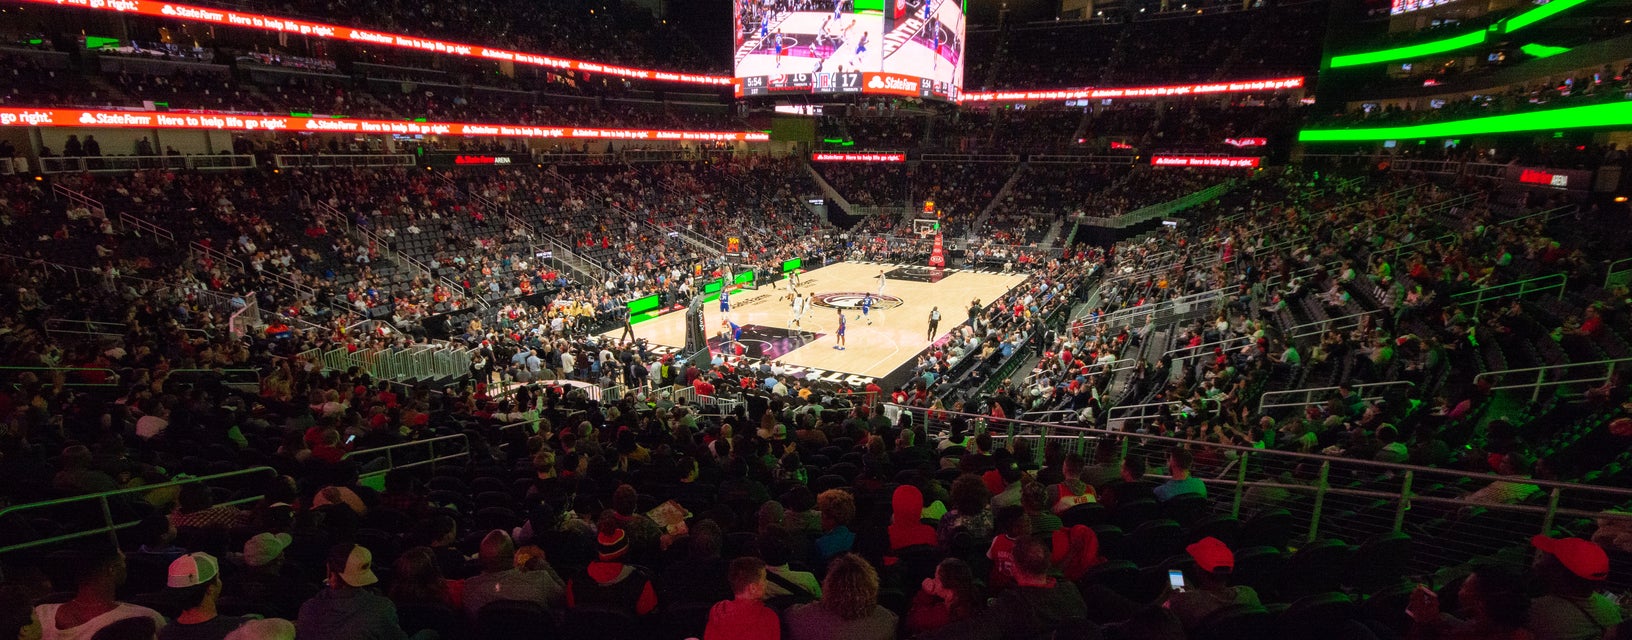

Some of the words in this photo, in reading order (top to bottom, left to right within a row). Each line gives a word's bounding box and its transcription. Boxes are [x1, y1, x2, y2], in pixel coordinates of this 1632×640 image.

[228, 14, 251, 24] Here
[253, 18, 262, 26] to
[264, 19, 283, 30] help
[285, 22, 298, 30] life
[300, 26, 311, 34] go
[747, 77, 762, 87] 5:54
[842, 74, 858, 87] 17
[0, 113, 16, 124] go
[157, 115, 184, 125] Here
[186, 117, 198, 125] to
[200, 117, 224, 128] help
[226, 118, 243, 126] life
[245, 120, 258, 129] go
